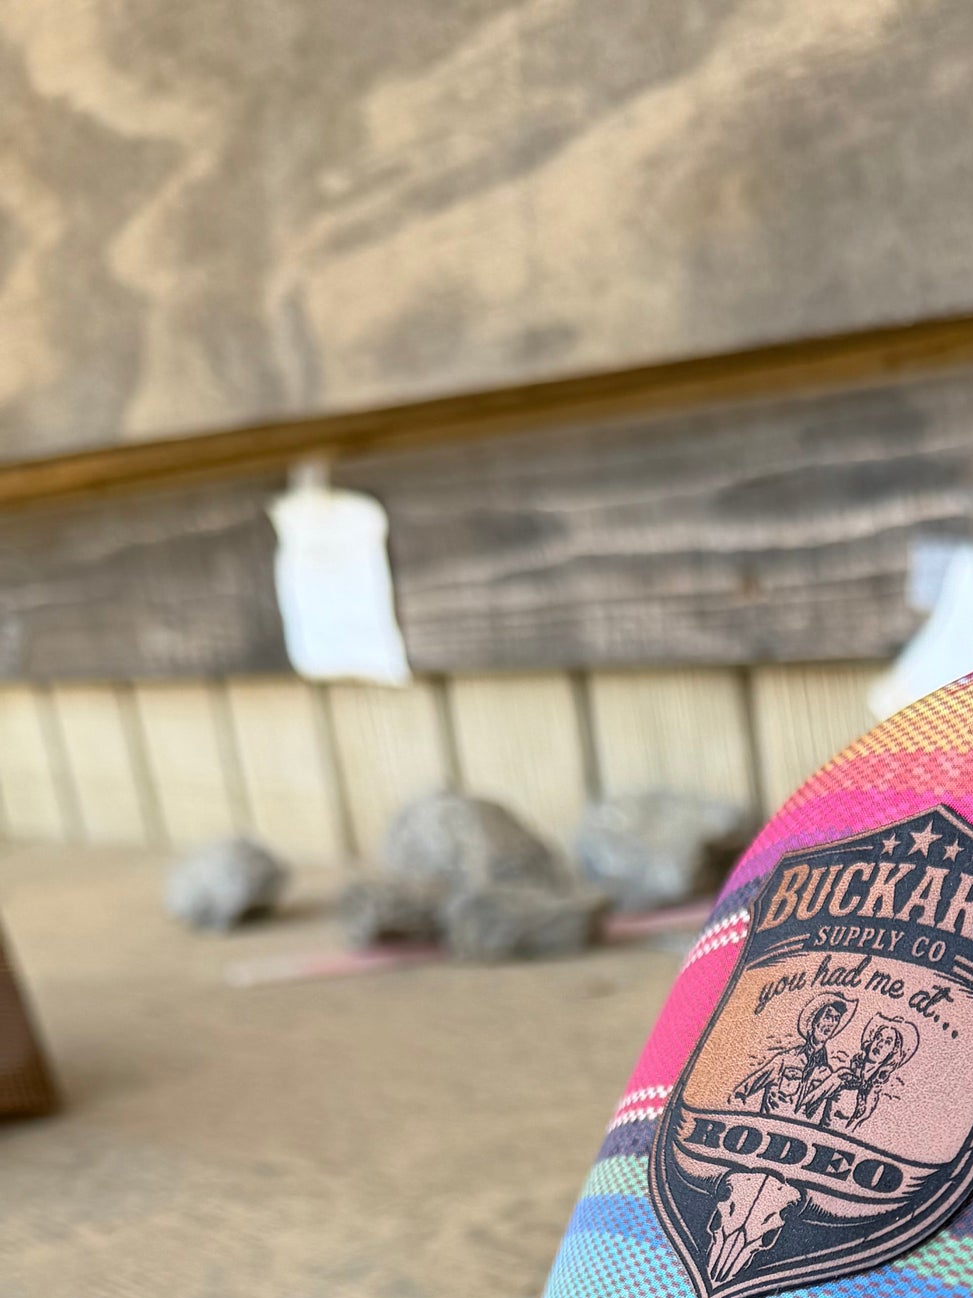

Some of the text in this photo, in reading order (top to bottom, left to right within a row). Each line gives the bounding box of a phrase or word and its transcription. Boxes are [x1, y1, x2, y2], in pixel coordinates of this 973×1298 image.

[814, 925, 947, 962] SUPPLY CO
[754, 971, 807, 1015] you
[811, 954, 873, 988] had
[865, 970, 905, 999] me
[682, 1118, 904, 1194] RODEO
